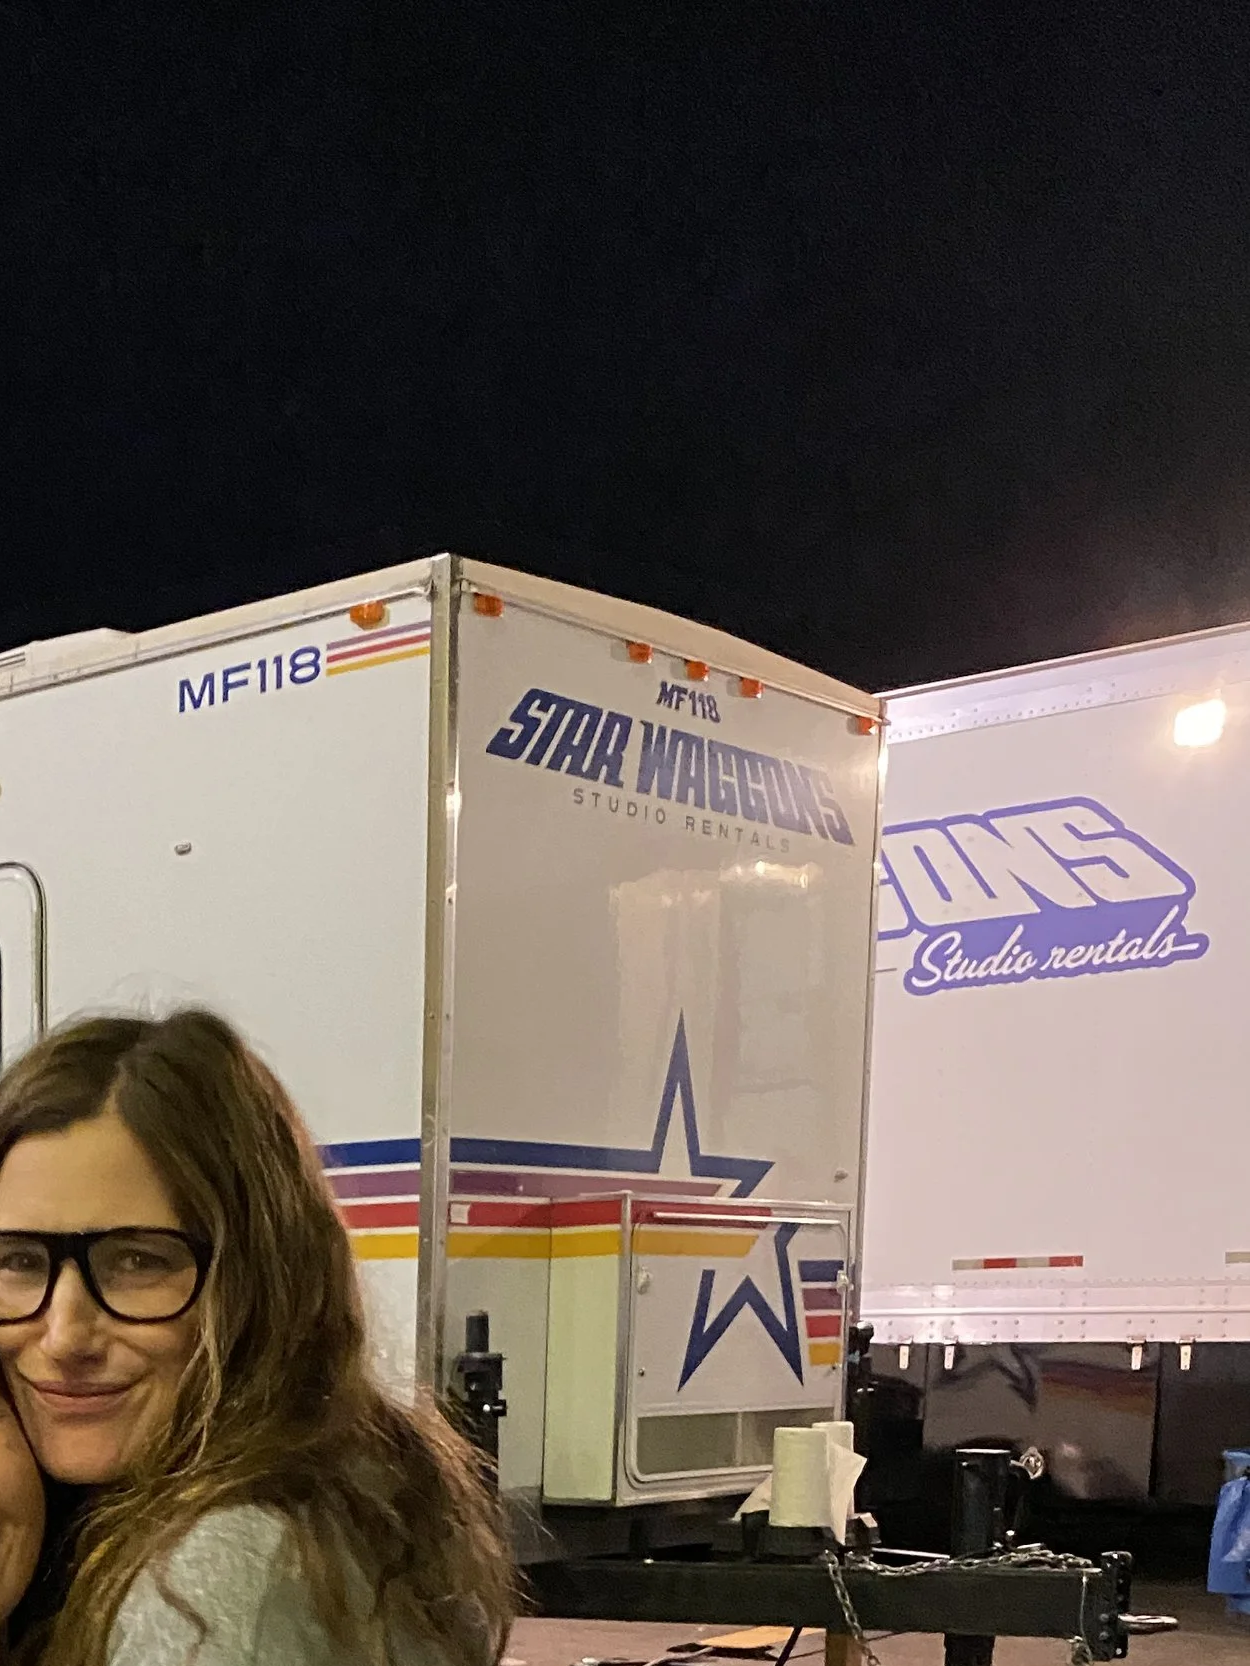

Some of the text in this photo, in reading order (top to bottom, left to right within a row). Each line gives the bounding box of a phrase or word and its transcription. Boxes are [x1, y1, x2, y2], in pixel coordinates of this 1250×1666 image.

[178, 645, 321, 713] MF118
[656, 681, 721, 723] MF118
[486, 687, 855, 846] STAR WAGGONS
[572, 787, 791, 854] STUDIO RENTALS
[910, 904, 1200, 989] Studio rentals
